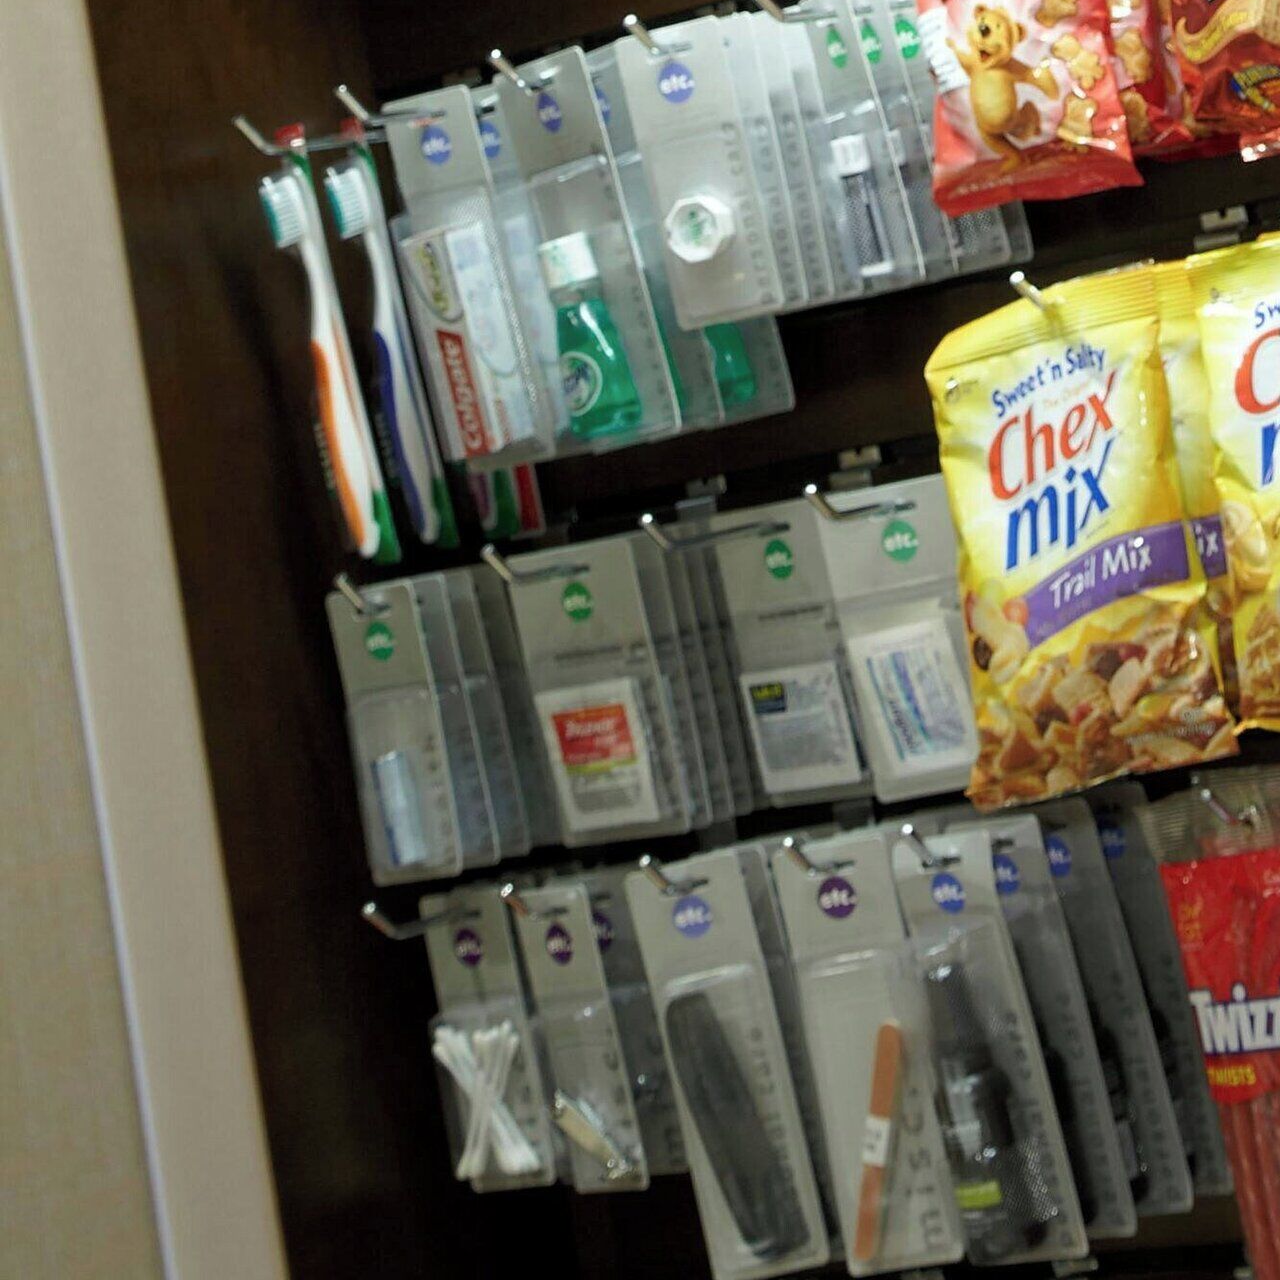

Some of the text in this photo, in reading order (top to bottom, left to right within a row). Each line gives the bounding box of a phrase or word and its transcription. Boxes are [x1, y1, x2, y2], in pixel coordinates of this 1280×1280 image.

[661, 71, 696, 96] etc.
[992, 363, 1045, 418] Sweet
[1066, 343, 1107, 375] Salty
[987, 368, 1118, 502] Chex
[1005, 437, 1117, 571] mix
[883, 531, 919, 553] etc.
[1049, 537, 1152, 609] Trail Mix
[819, 892, 858, 910] etc.
